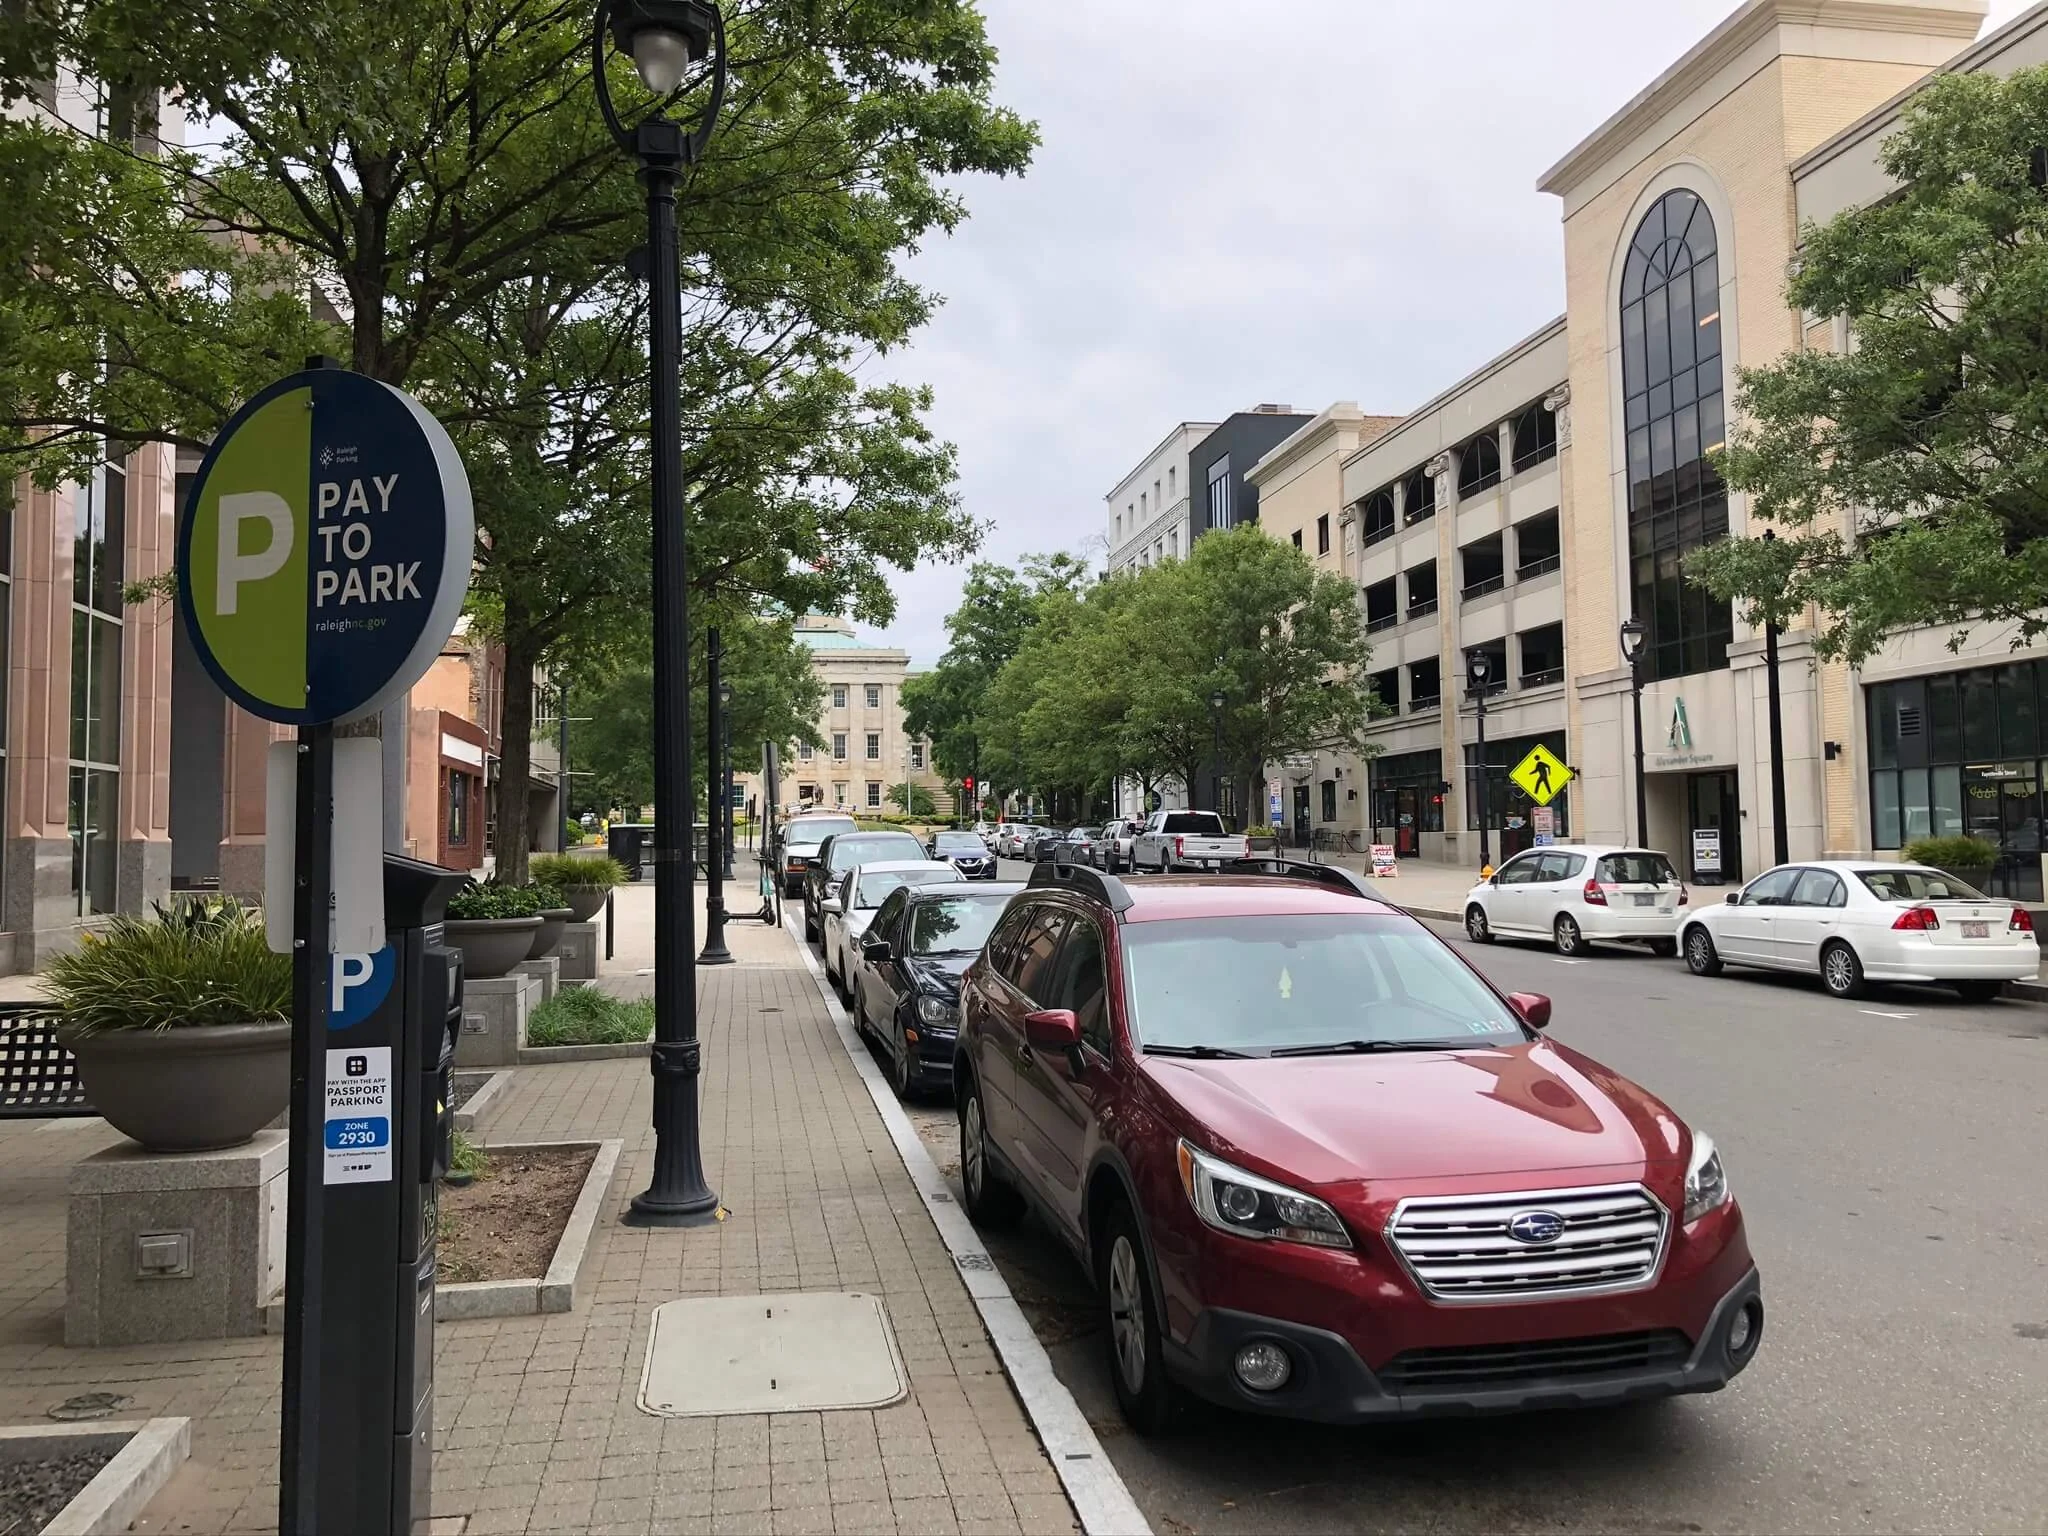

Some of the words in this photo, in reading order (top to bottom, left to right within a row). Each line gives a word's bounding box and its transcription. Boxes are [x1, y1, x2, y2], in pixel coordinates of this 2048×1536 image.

[318, 473, 399, 519] PAY
[216, 491, 294, 616] P
[317, 522, 372, 562] TO
[316, 561, 422, 608] PARK
[315, 618, 386, 633] raleighnc.gov
[332, 953, 374, 1012] P
[327, 1085, 386, 1096] PASSPORT
[331, 1096, 383, 1107] PARKING
[338, 1131, 376, 1145] 2930
[344, 1121, 369, 1131] ZONE
